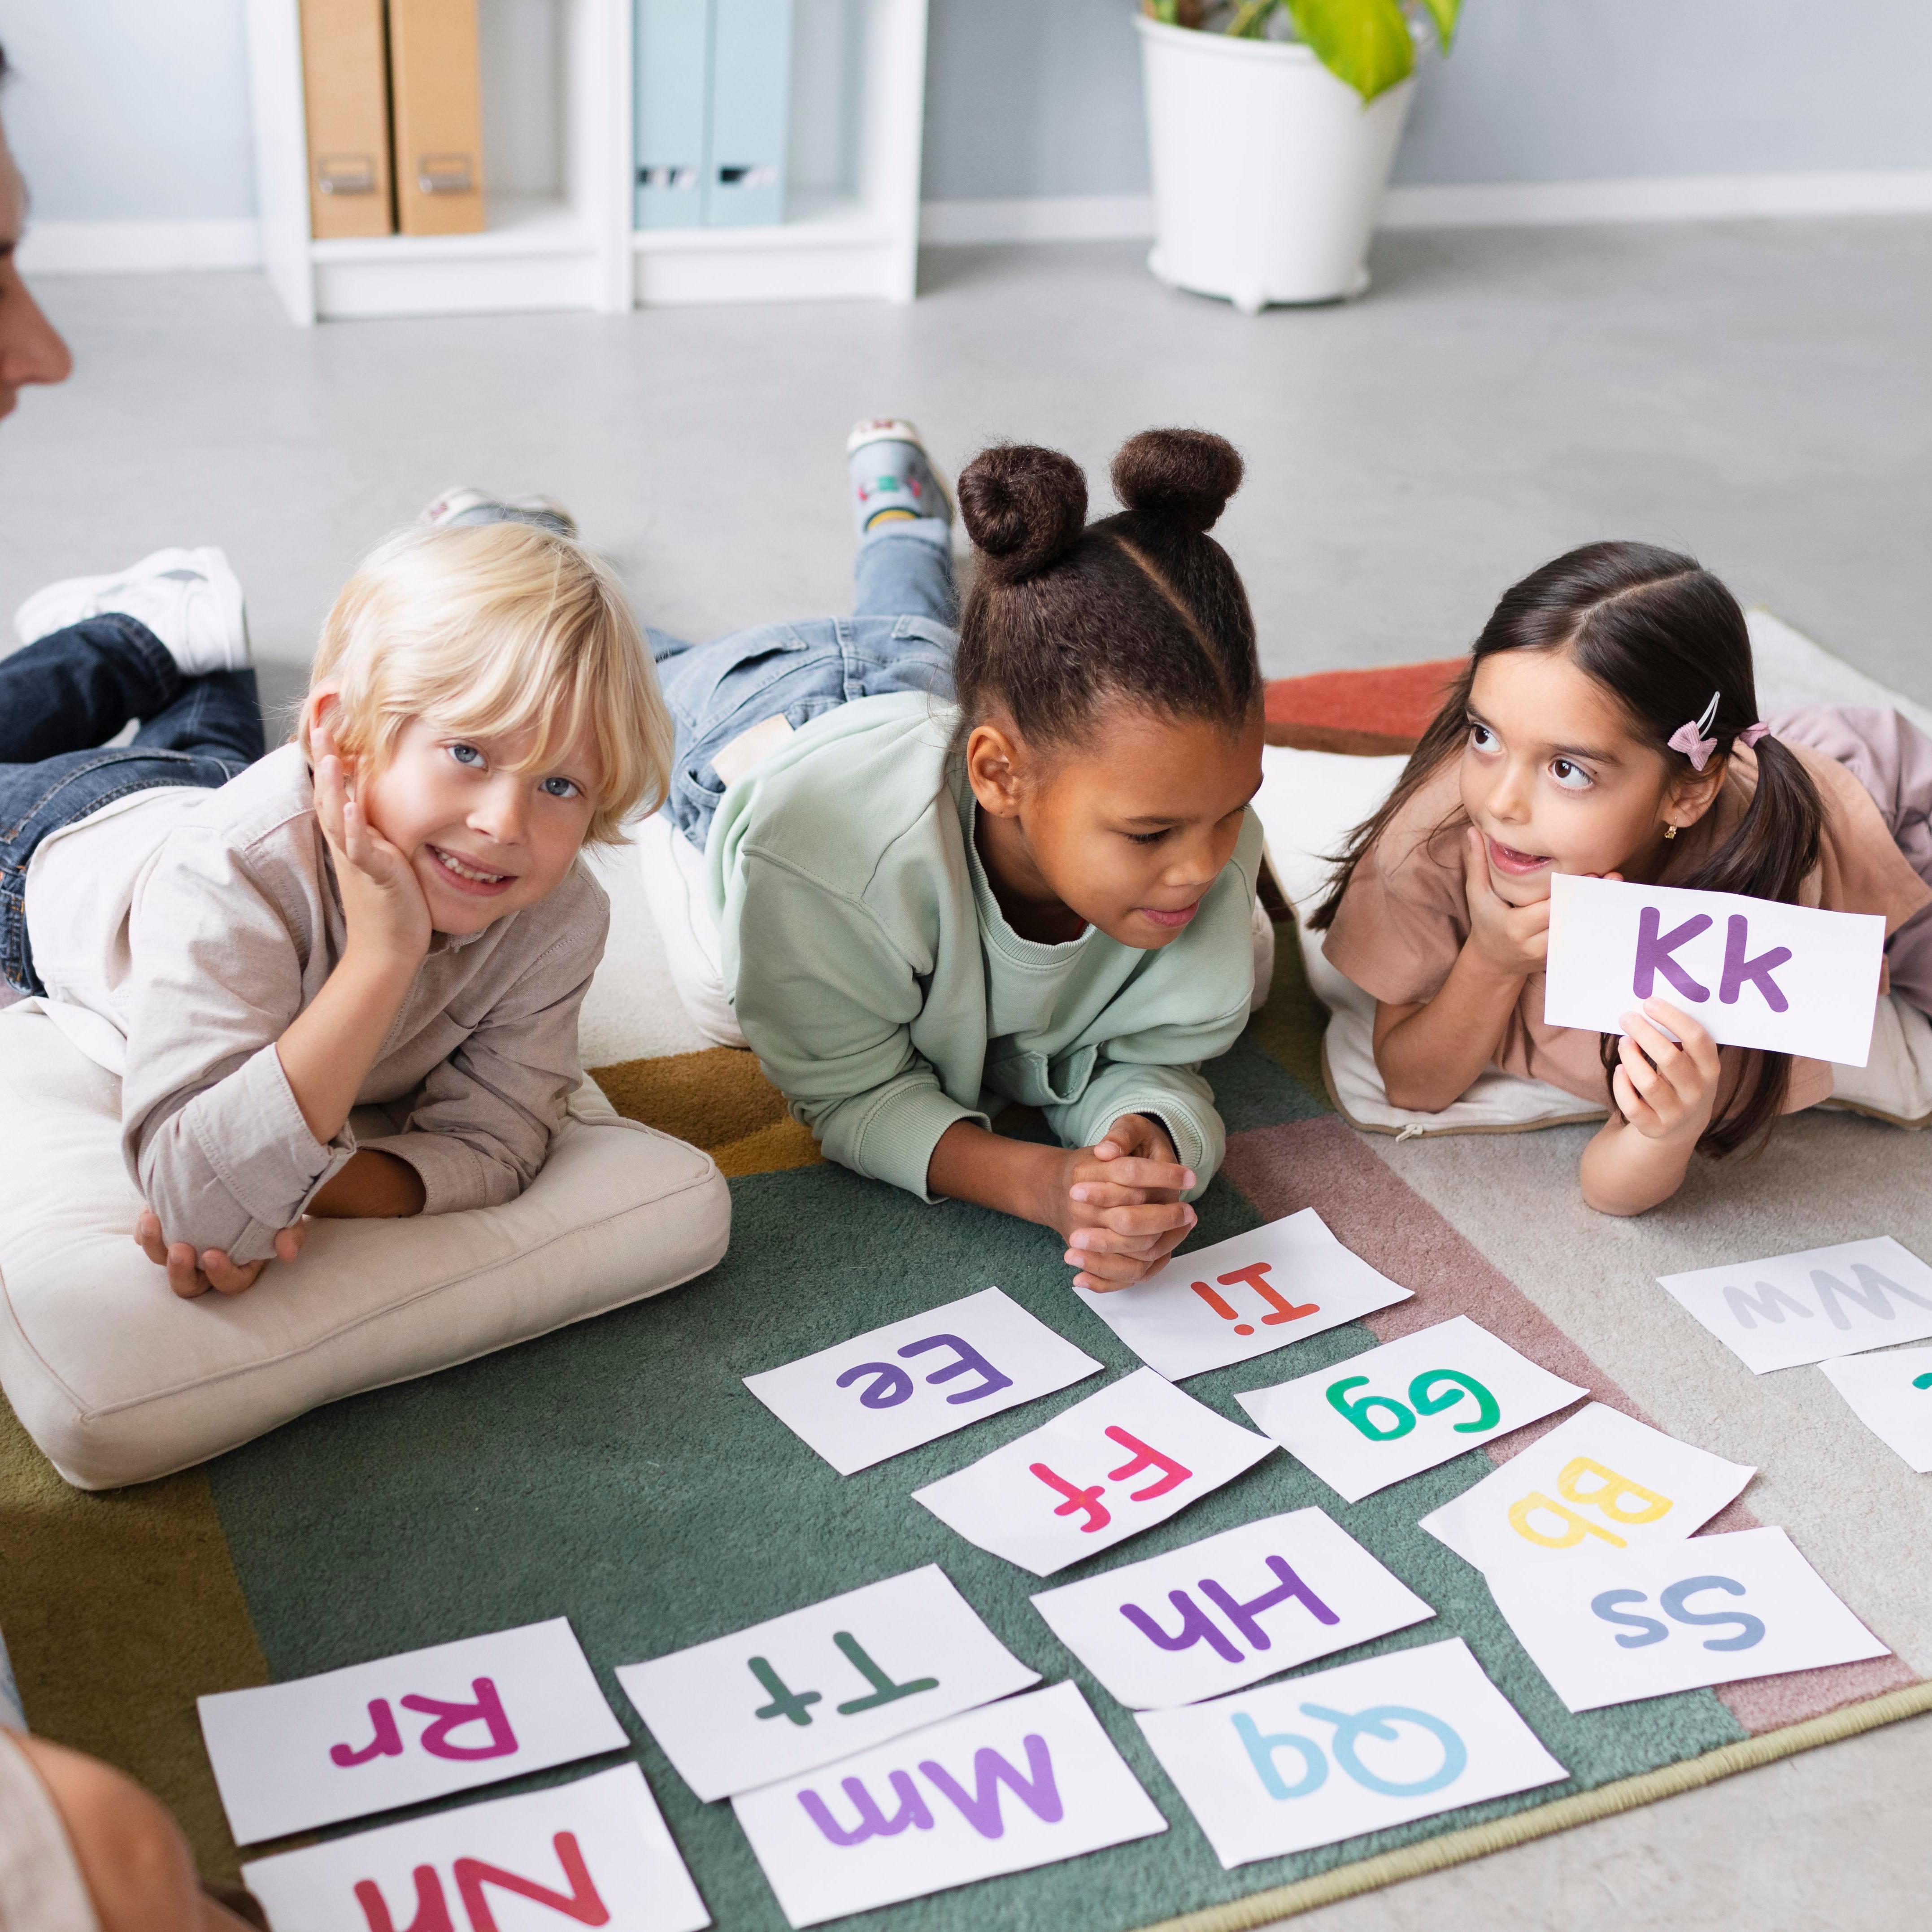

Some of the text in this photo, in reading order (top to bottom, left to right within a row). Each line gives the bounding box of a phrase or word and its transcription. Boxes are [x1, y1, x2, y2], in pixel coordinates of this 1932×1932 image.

[1633, 906, 1792, 1013] Kk
[1190, 1262, 1320, 1336] Ii
[1723, 1263, 1932, 1330] Ww
[836, 1334, 1013, 1409] Ee
[1326, 1369, 1501, 1441] Gg
[1029, 1425, 1193, 1533] Ff
[1509, 1457, 1673, 1548] Bb
[1119, 1555, 1340, 1664] Hh
[1591, 1575, 1766, 1651] Ss
[328, 1676, 519, 1769] Rr
[747, 1631, 940, 1727] Tt
[796, 1733, 1064, 1847] Mm
[1232, 1703, 1467, 1799] Qq
[352, 1830, 611, 1932] Nn
